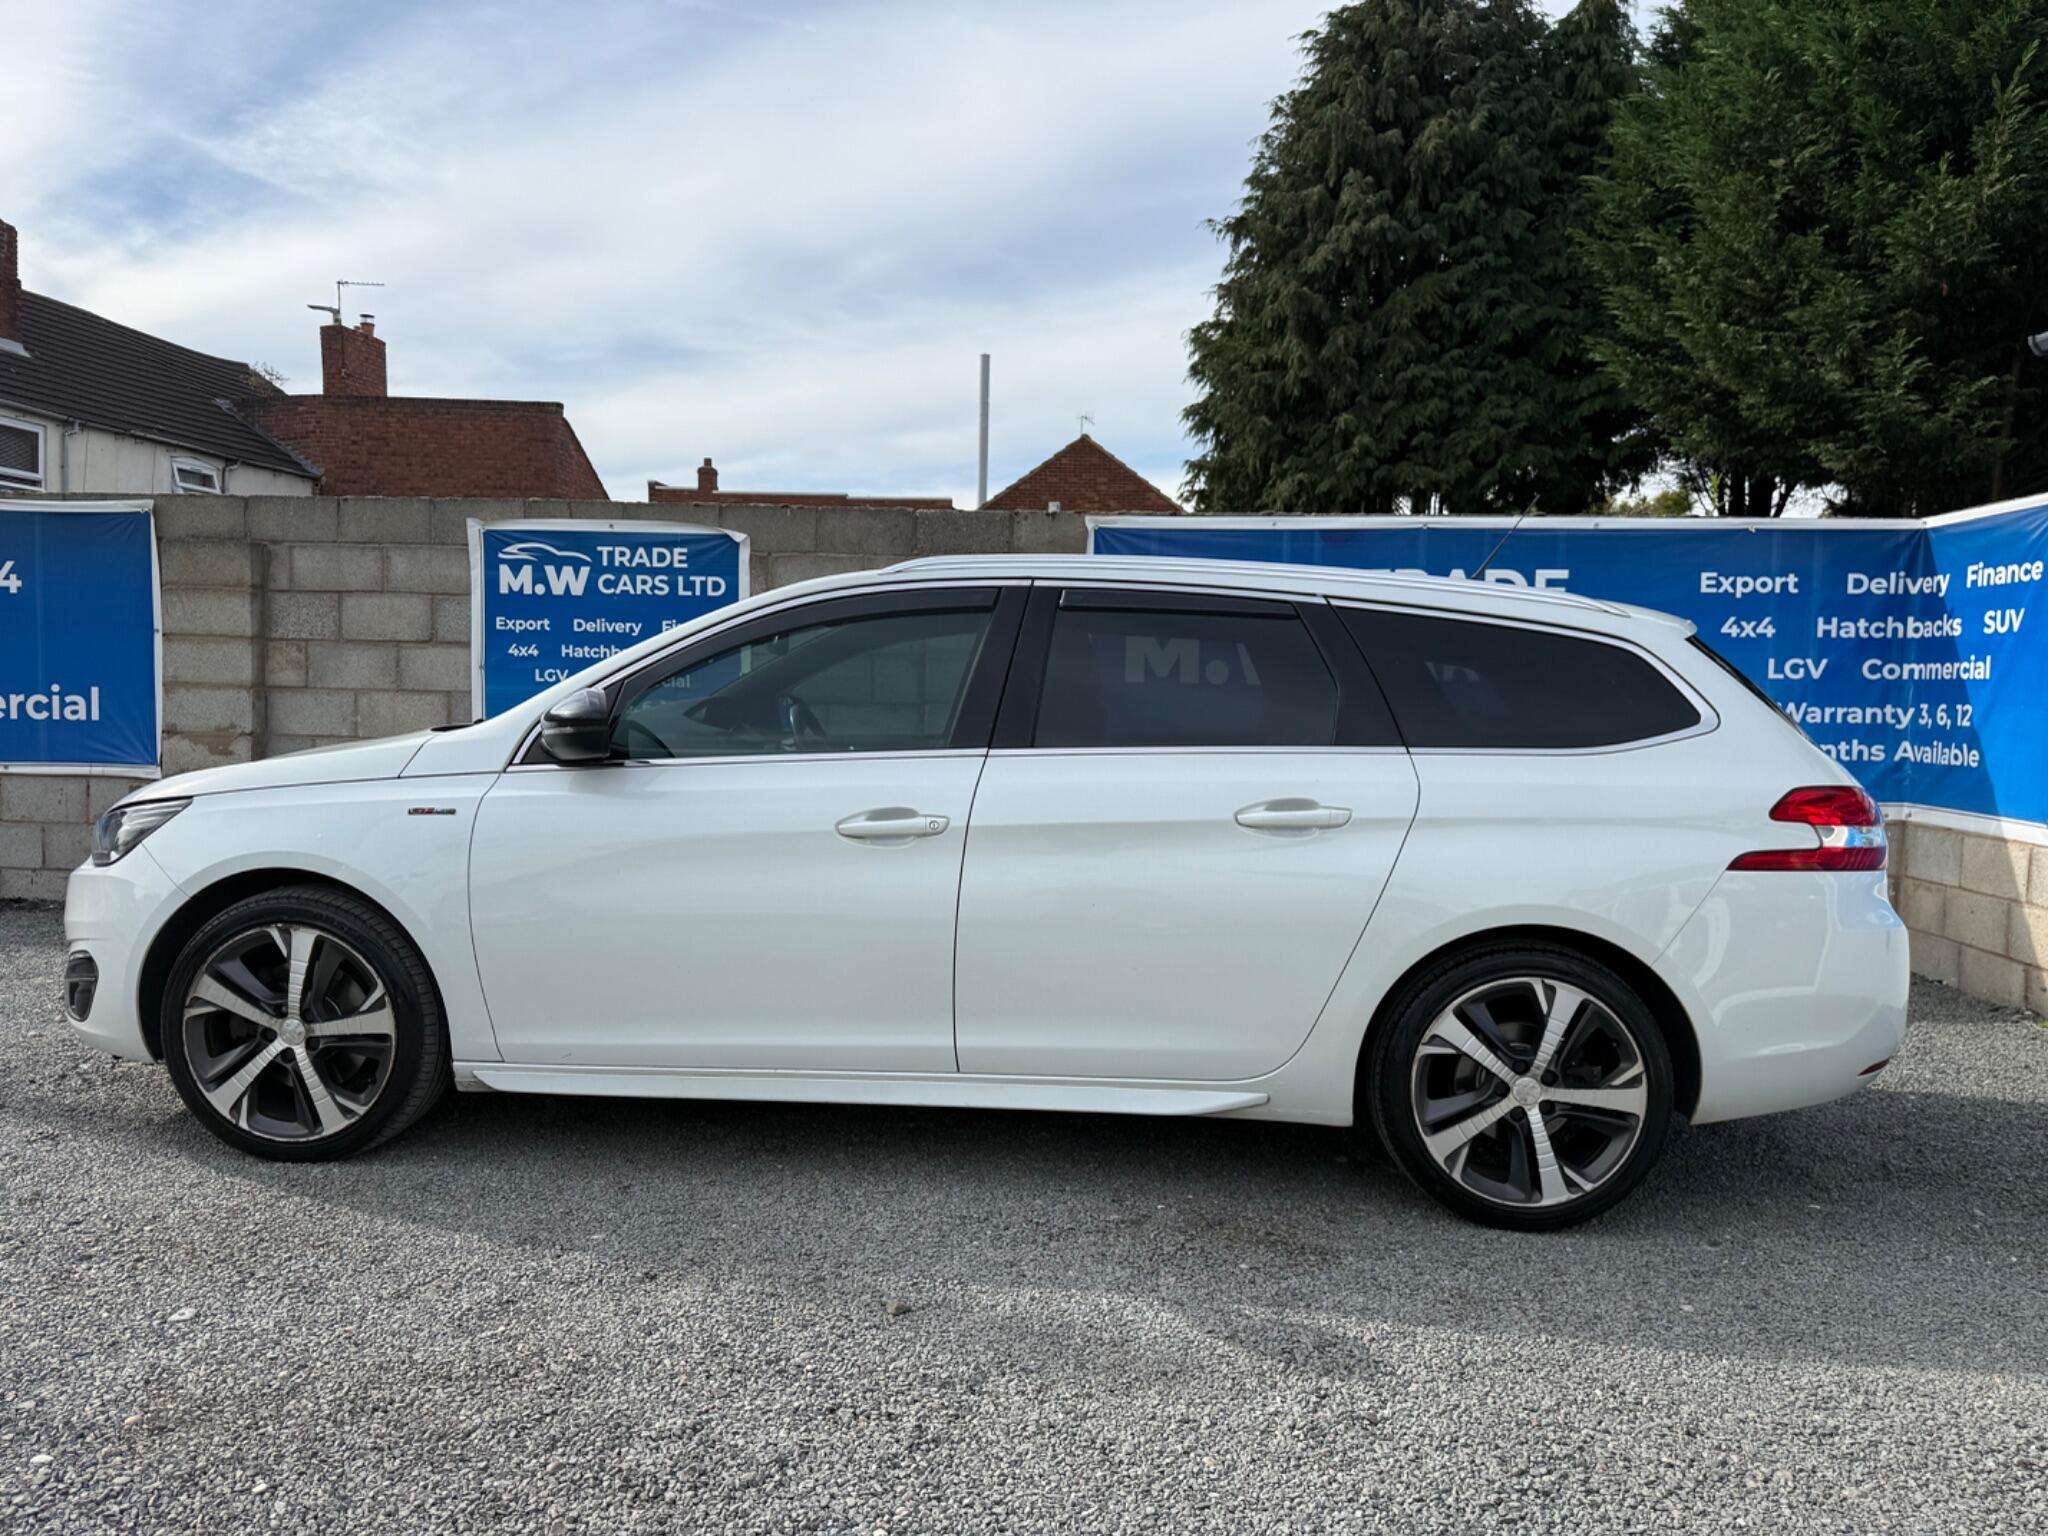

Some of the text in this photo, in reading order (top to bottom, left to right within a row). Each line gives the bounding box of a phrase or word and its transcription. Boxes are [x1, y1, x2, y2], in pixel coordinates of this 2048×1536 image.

[597, 546, 688, 568] TRADE
[499, 564, 590, 596] M.W
[597, 574, 726, 597] CARS LTD
[1700, 560, 2044, 598] Export Delivery Finance
[495, 616, 550, 633] Export
[573, 618, 642, 636] Delivery
[1720, 608, 2025, 639] 4x4 Hatchbacks SUV
[507, 643, 539, 657] 4x4
[535, 669, 568, 683] LGV
[1767, 654, 1990, 681] LGV Commercial
[0, 684, 100, 721] rcial
[1919, 703, 1932, 728] 3,
[1936, 704, 1951, 730] 6,
[1956, 703, 1973, 727] 12
[1894, 740, 1980, 768] Available
